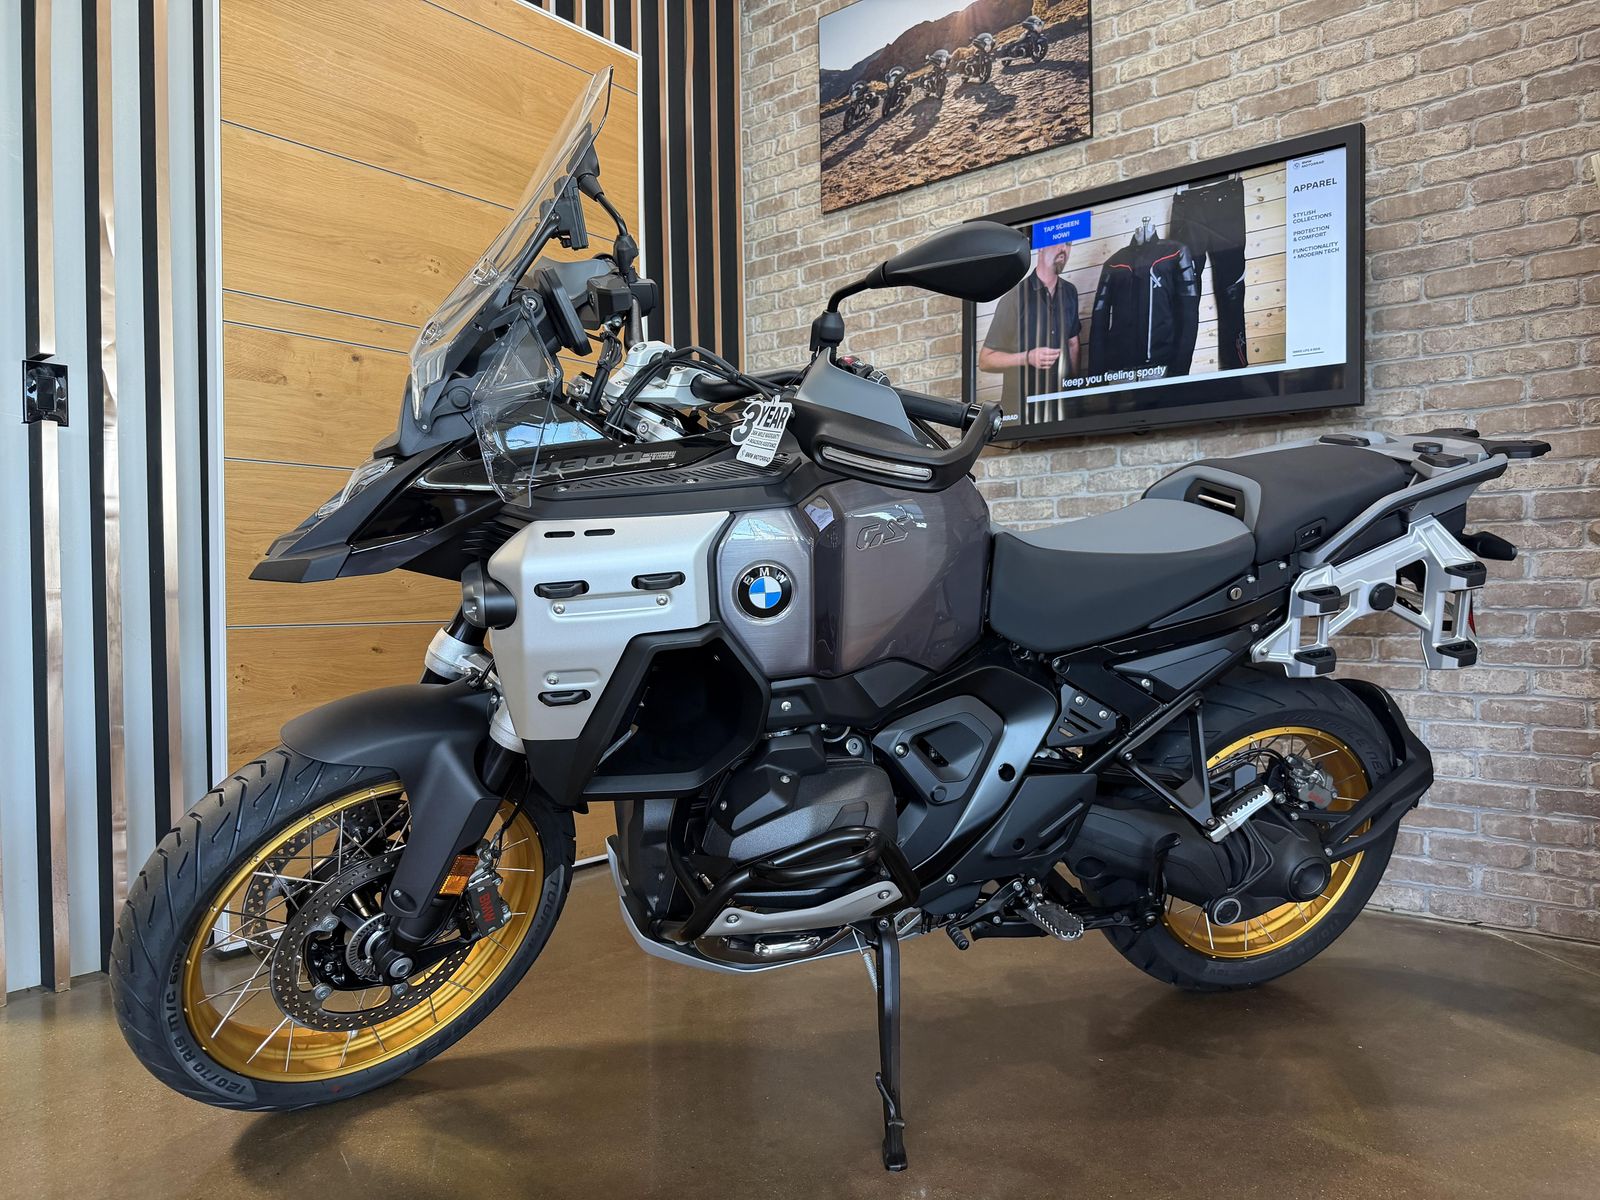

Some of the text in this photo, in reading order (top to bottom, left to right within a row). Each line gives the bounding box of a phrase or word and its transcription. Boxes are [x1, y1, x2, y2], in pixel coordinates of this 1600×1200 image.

[1293, 177, 1338, 193] APPAREL
[1293, 209, 1316, 218] STYLISH
[1293, 212, 1332, 224] COLLECTIONS
[1043, 219, 1080, 233] TAP SCREEN
[1293, 225, 1330, 236] PROTECTION
[1052, 231, 1070, 240] NOW!
[1298, 231, 1327, 241] COMFORT
[1293, 241, 1339, 254] FUNCTIONALITY
[1297, 249, 1323, 259] MODERN
[1324, 247, 1340, 255] TECH
[1062, 365, 1168, 388] keep you feeling sporty
[732, 403, 790, 443] 3 YEAR
[856, 504, 909, 550] GS
[743, 567, 788, 586] BMW
[479, 891, 496, 923] BMW
[193, 1063, 247, 1095] 120/70
